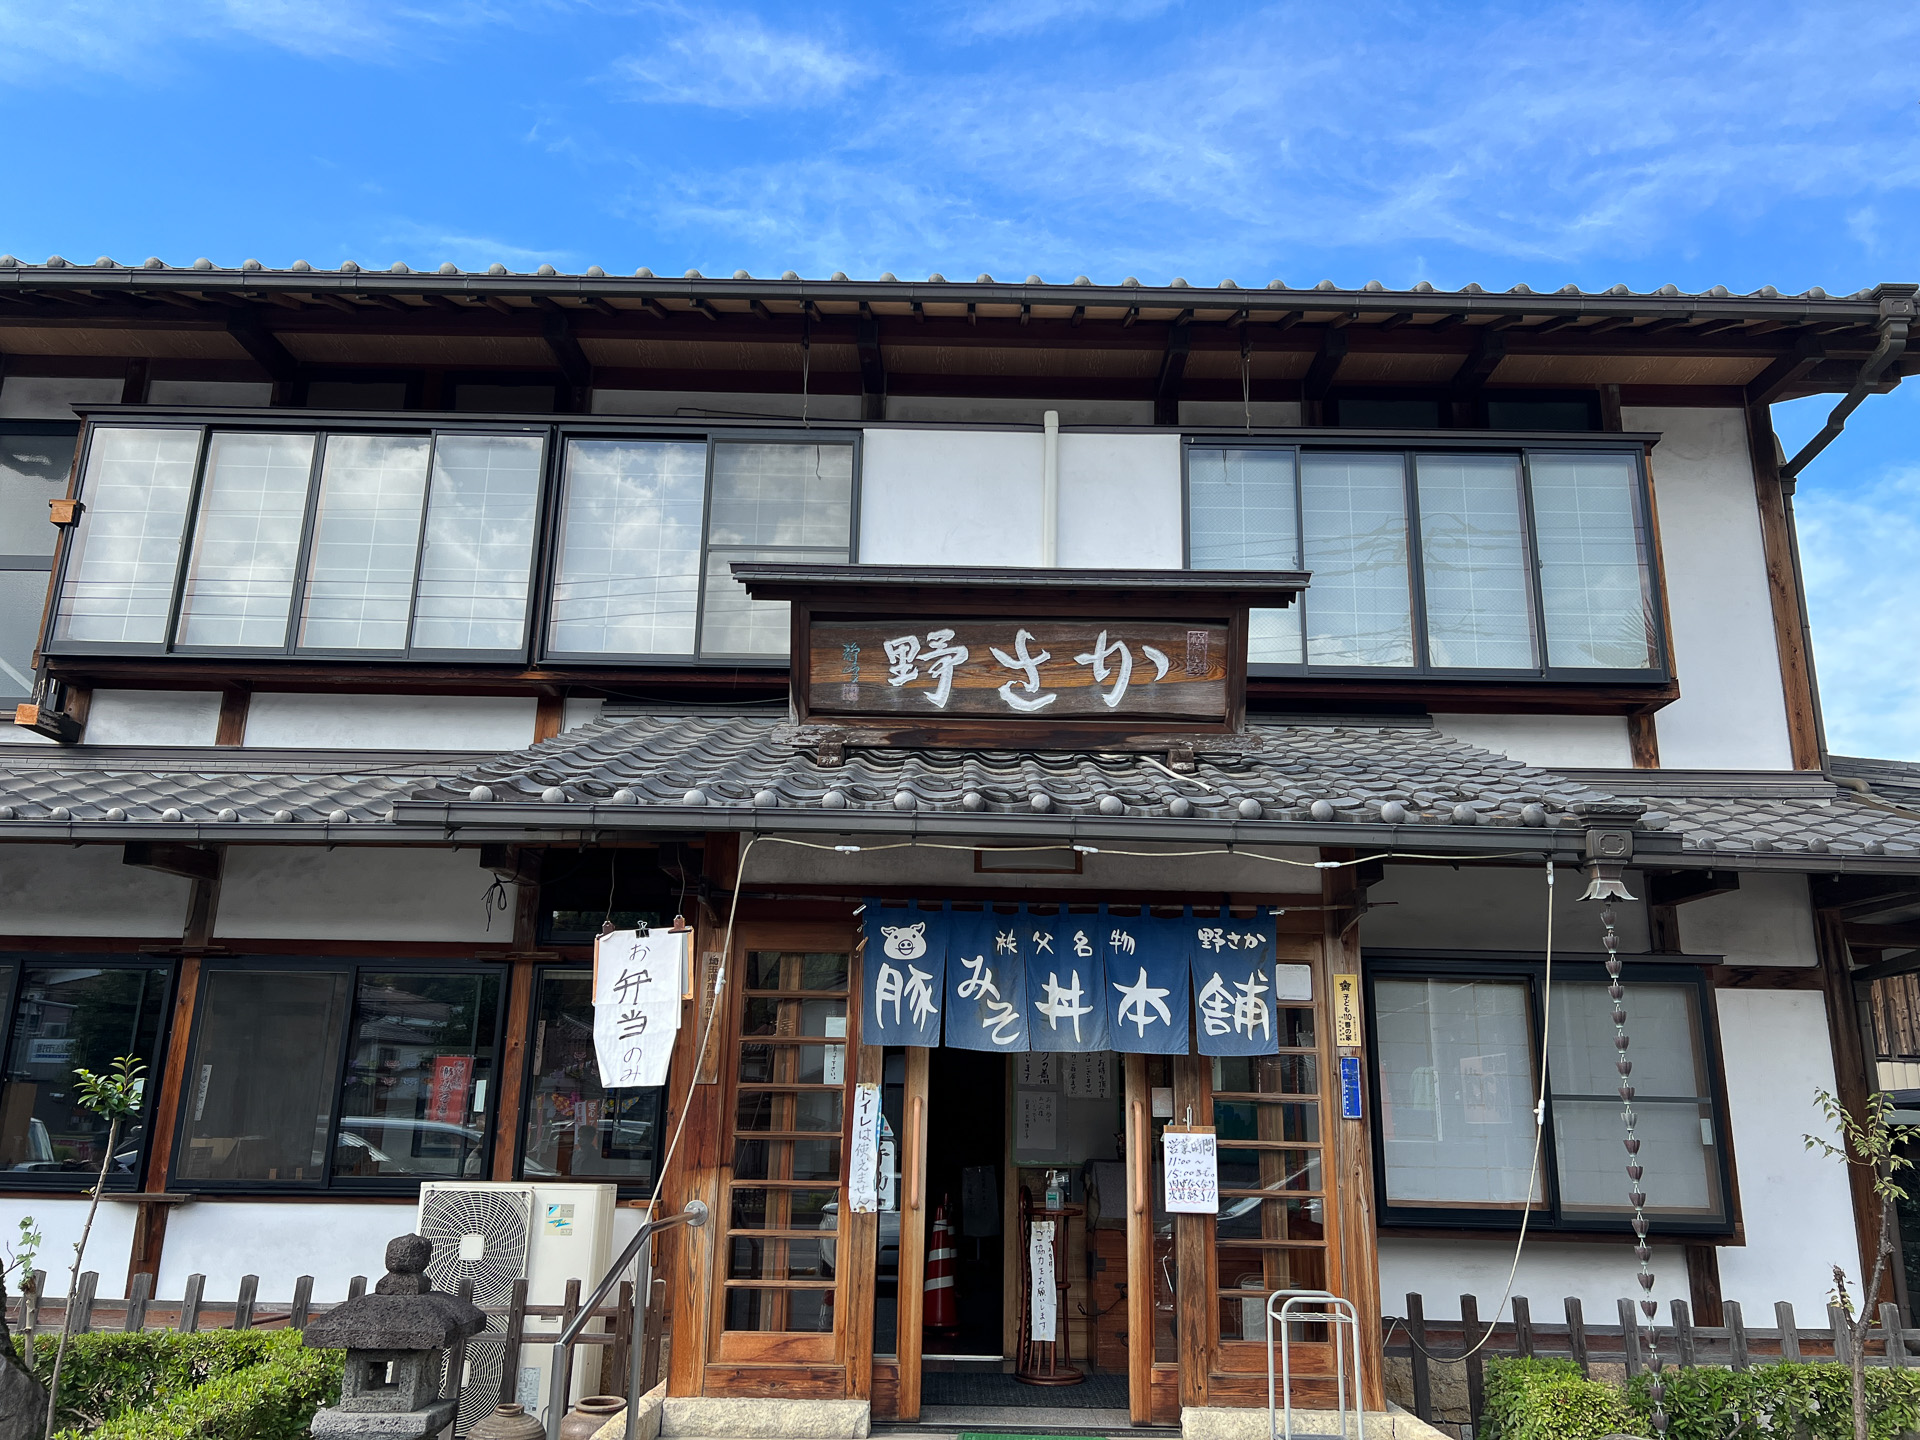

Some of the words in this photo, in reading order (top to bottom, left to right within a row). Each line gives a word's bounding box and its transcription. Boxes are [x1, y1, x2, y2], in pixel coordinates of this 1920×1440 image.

[882, 628, 1171, 712] 野さか
[995, 928, 1136, 958] 秩父名物
[1197, 927, 1267, 955] 野さか
[612, 944, 653, 1083] お弁当のみ
[876, 954, 1271, 1045] 豚みそ丼本舗
[855, 1089, 872, 1207] トイレは使えません
[1167, 1138, 1214, 1156] 営業時間
[1035, 1230, 1047, 1331] ご協力をお願いします
